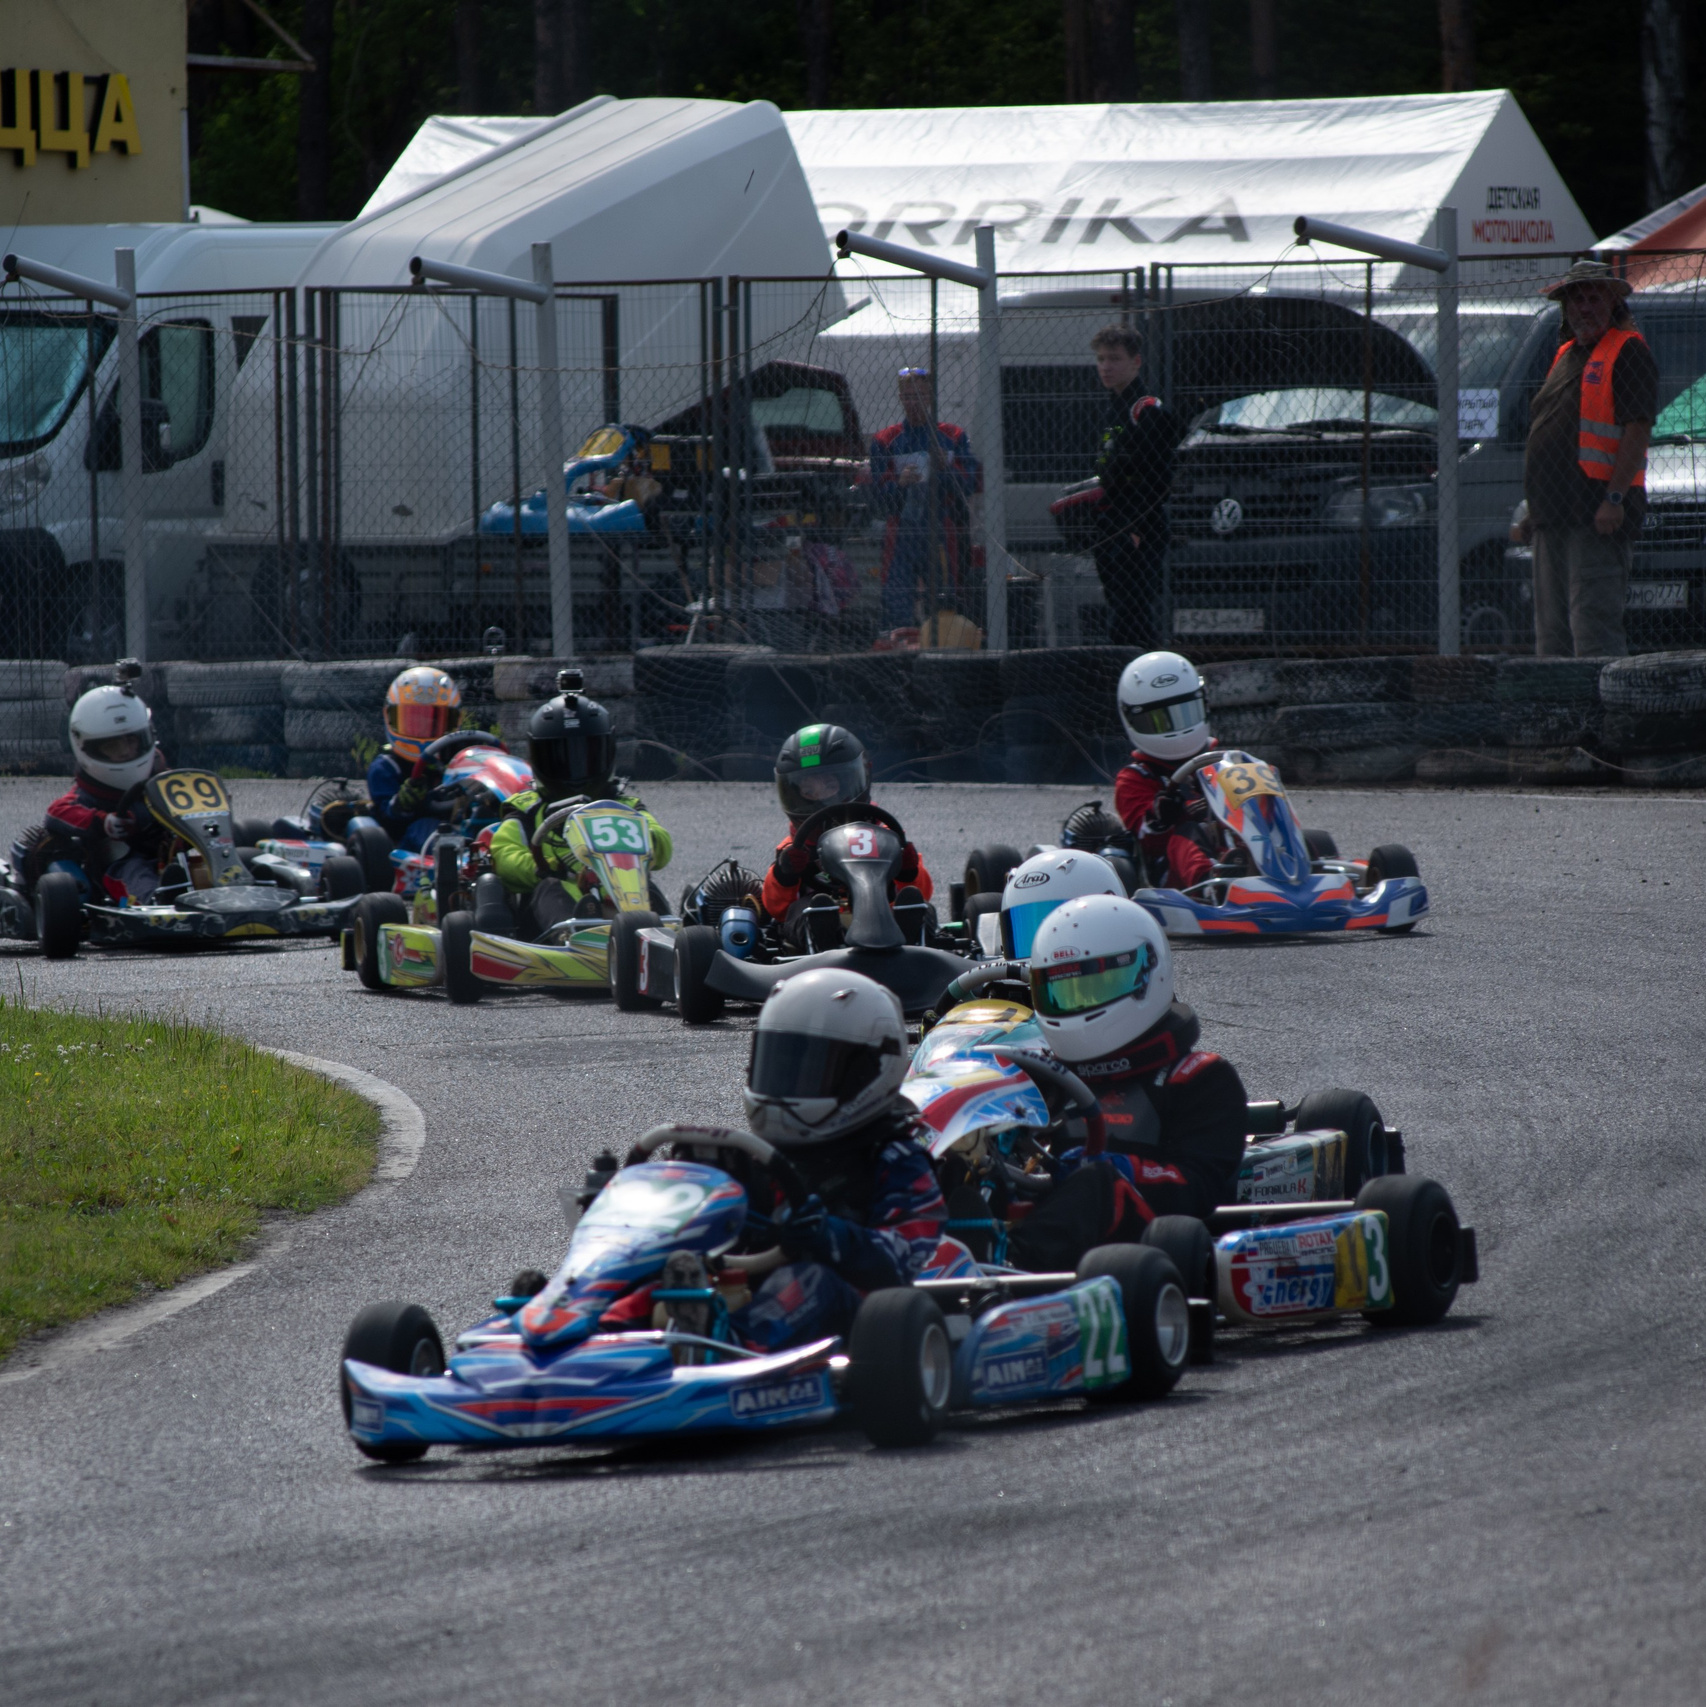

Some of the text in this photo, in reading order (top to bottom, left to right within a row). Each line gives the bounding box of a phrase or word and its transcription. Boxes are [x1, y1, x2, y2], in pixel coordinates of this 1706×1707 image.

[1486, 186, 1541, 213] ДЕТСКАЯ
[1472, 219, 1556, 243] МОТОШКОЛА
[1226, 765, 1281, 795] 39
[165, 778, 222, 810] 69
[591, 817, 644, 850] 53
[850, 828, 874, 856] 3
[1019, 873, 1047, 886] Arai
[1053, 949, 1076, 959] BELL
[1077, 1058, 1131, 1077] sparco
[1255, 1178, 1307, 1197] FORMULA K
[1300, 1231, 1334, 1247] ROTAX
[1364, 1215, 1389, 1301] 3
[1077, 1284, 1127, 1378] 22
